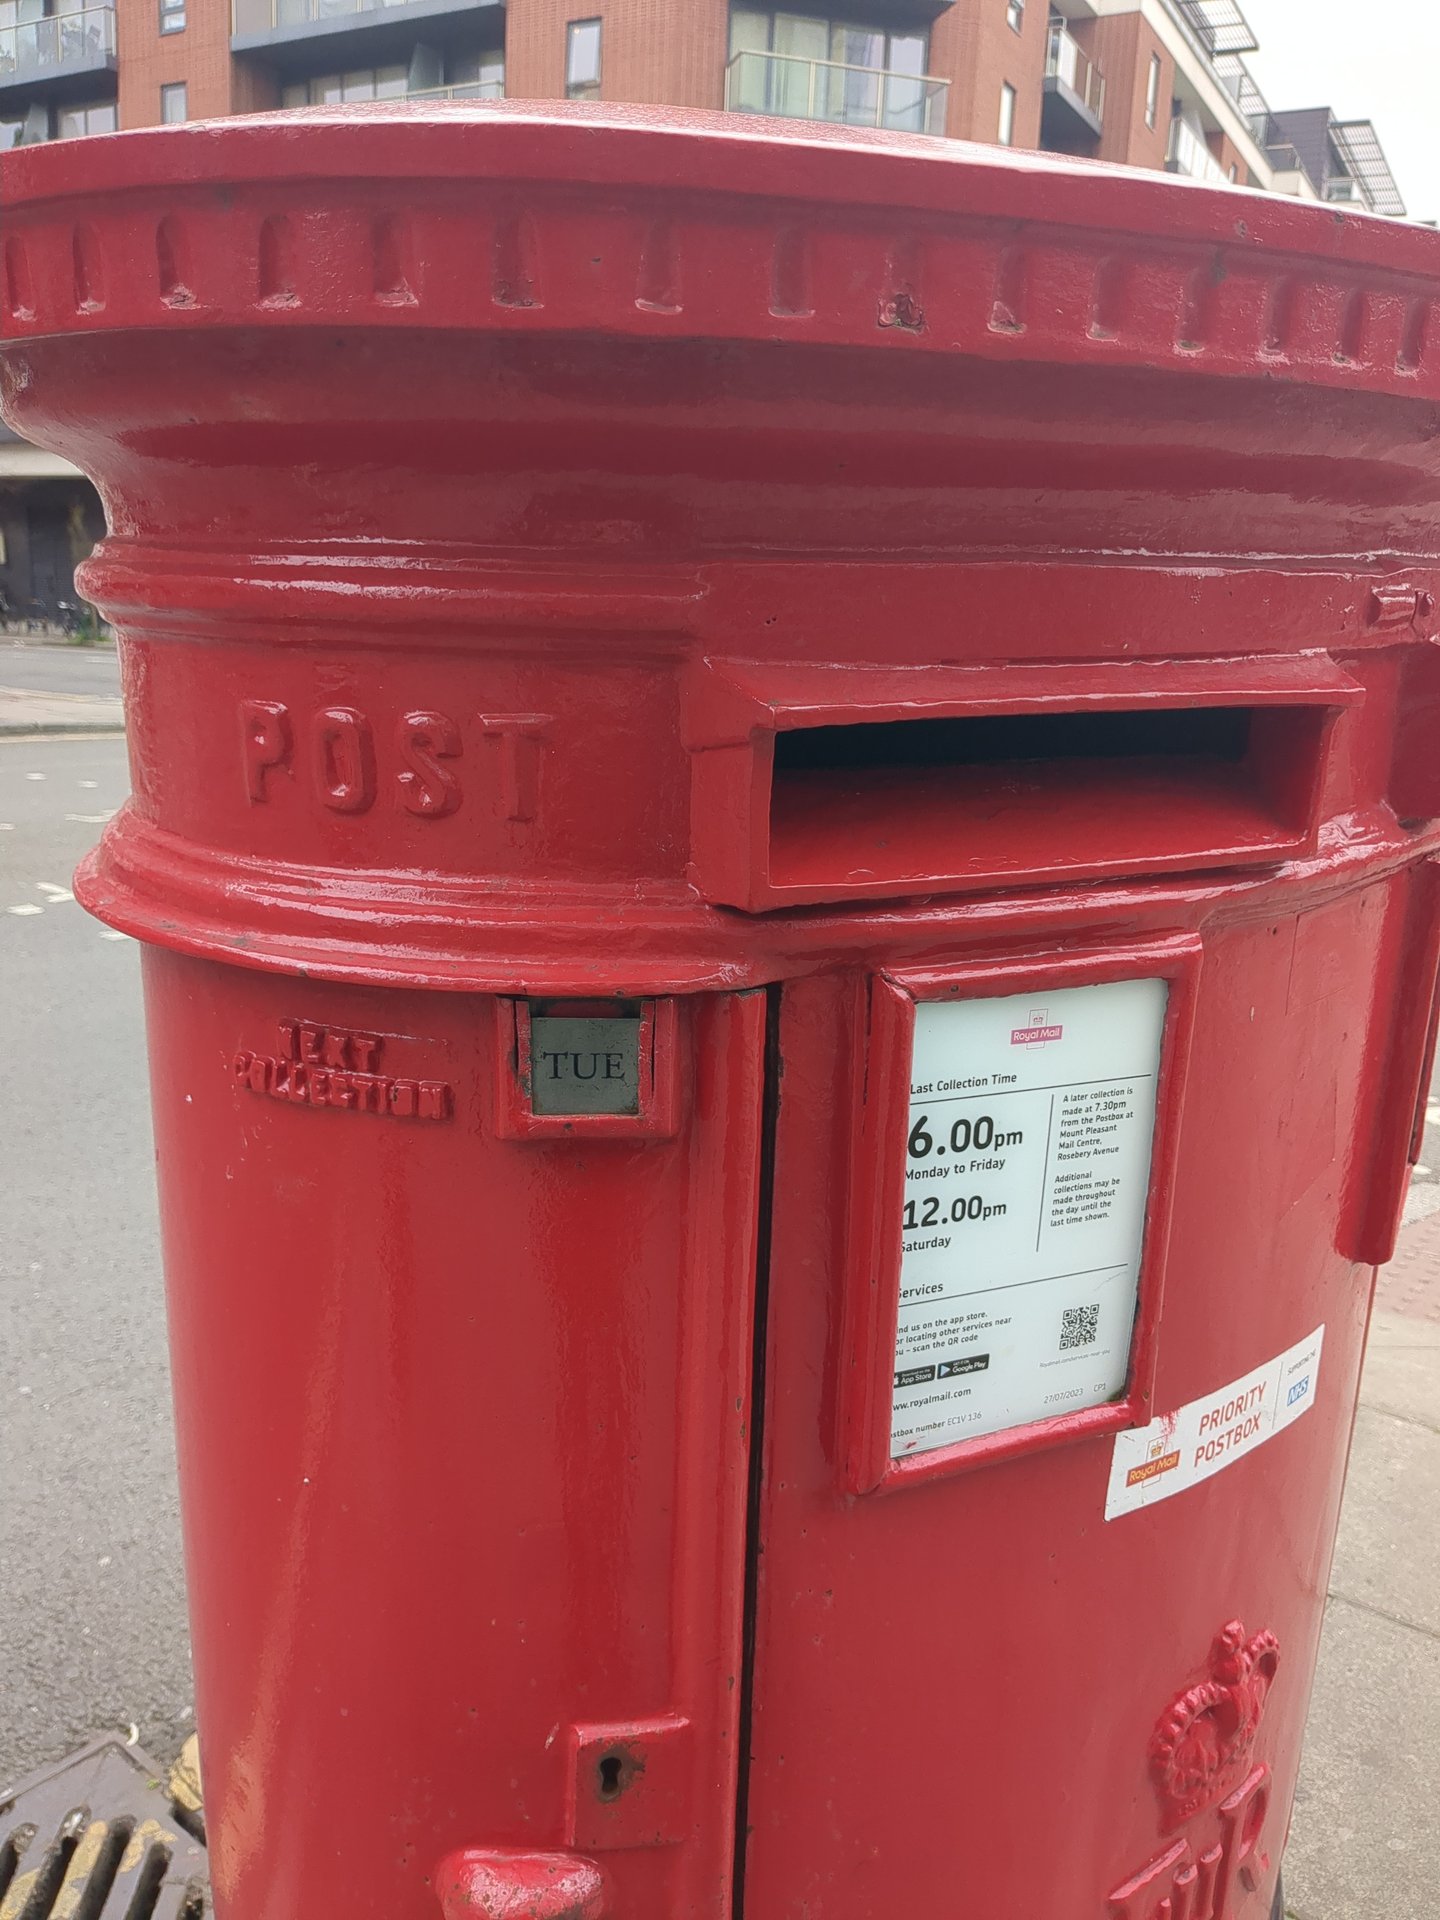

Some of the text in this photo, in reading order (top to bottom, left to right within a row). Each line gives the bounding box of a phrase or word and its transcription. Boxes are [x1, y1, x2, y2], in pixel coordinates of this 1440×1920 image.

[240, 699, 556, 824] POST
[1013, 1027, 1060, 1042] Royal Mail
[278, 1018, 384, 1072] NEXT
[542, 1051, 626, 1080] TUE
[234, 1050, 455, 1121] COLLECTION
[910, 1073, 1017, 1095] Last Collection Time
[1063, 1087, 1133, 1103] A later collection is
[1062, 1107, 1082, 1116] made
[1095, 1101, 1126, 1112] 7.30pm
[1061, 1119, 1078, 1127] from
[1081, 1117, 1093, 1125] the
[1095, 1112, 1124, 1122] Postbox
[908, 1115, 1023, 1158] 6.00pm
[1060, 1124, 1117, 1139] Mount Pleasant
[1057, 1146, 1119, 1161] Rosebery Avenue
[1058, 1140, 1074, 1150] Mail
[906, 1159, 1006, 1180] Monday to Friday
[1055, 1170, 1092, 1183] Additional
[1053, 1189, 1116, 1205] made throughout
[1054, 1182, 1092, 1194] collections
[1094, 1180, 1109, 1189] may
[902, 1195, 1007, 1230] 12.00pm
[1051, 1200, 1112, 1216] the day until the
[1050, 1212, 1109, 1227] last time shown.
[906, 1331, 937, 1344] locating
[939, 1327, 960, 1337] other
[962, 1320, 993, 1332] services
[995, 1317, 1012, 1326] near
[911, 1324, 920, 1332] us
[922, 1321, 933, 1329] on
[935, 1318, 948, 1327] the
[949, 1315, 964, 1325] app
[966, 1311, 988, 1321] store.
[912, 1344, 931, 1353] scan
[933, 1340, 946, 1349] the
[947, 1337, 959, 1346] QR
[960, 1333, 979, 1343] code
[952, 1361, 987, 1373] Google Play
[900, 1372, 932, 1385] App Store
[893, 1388, 972, 1411] ww.royalmail.com
[1043, 1387, 1084, 1404] 27/07/2023
[1288, 1376, 1308, 1405] NHS
[1199, 1380, 1267, 1436] PRIORITY
[915, 1420, 946, 1433] number
[947, 1415, 967, 1426] EC1V
[967, 1411, 982, 1421] 136
[1194, 1411, 1262, 1468] POSTBOX
[1129, 1453, 1178, 1482] Royal Mail
